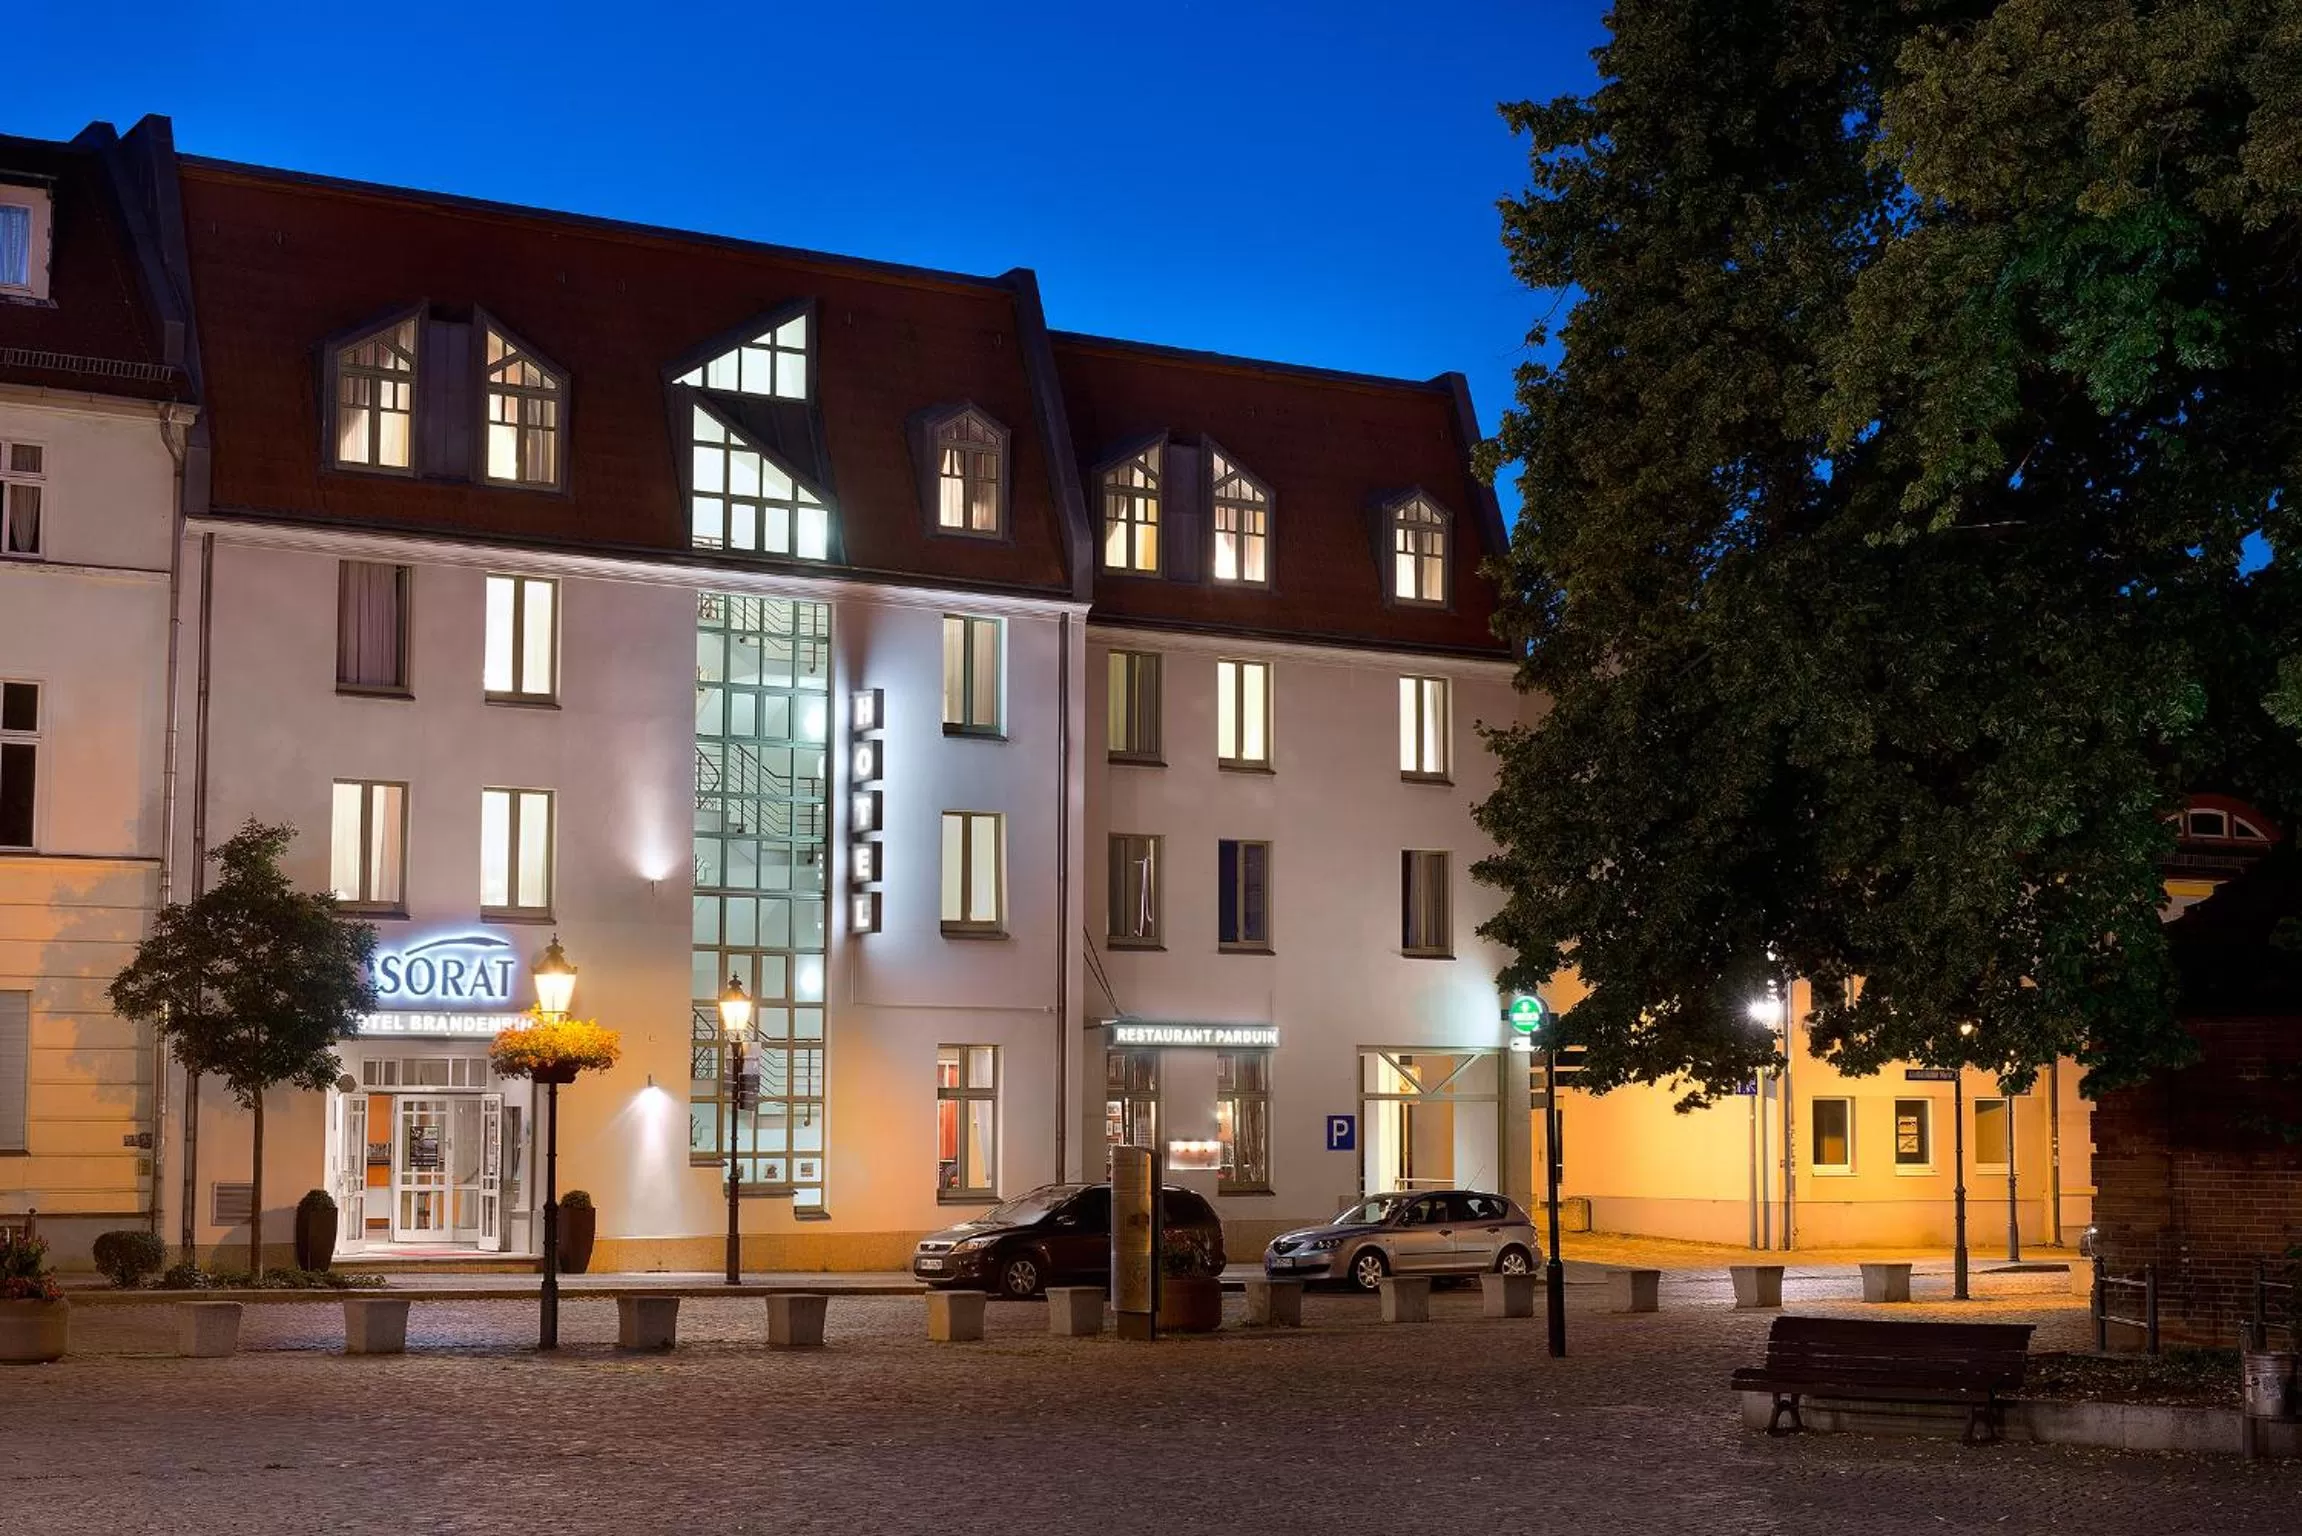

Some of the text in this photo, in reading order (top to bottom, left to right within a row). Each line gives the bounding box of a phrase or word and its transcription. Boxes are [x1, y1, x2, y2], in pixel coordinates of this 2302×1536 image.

[855, 695, 873, 928] HOTEL
[379, 956, 514, 997] SORAT
[1117, 1028, 1278, 1044] RESTAURANT PARDUIN
[1333, 1120, 1348, 1147] P
